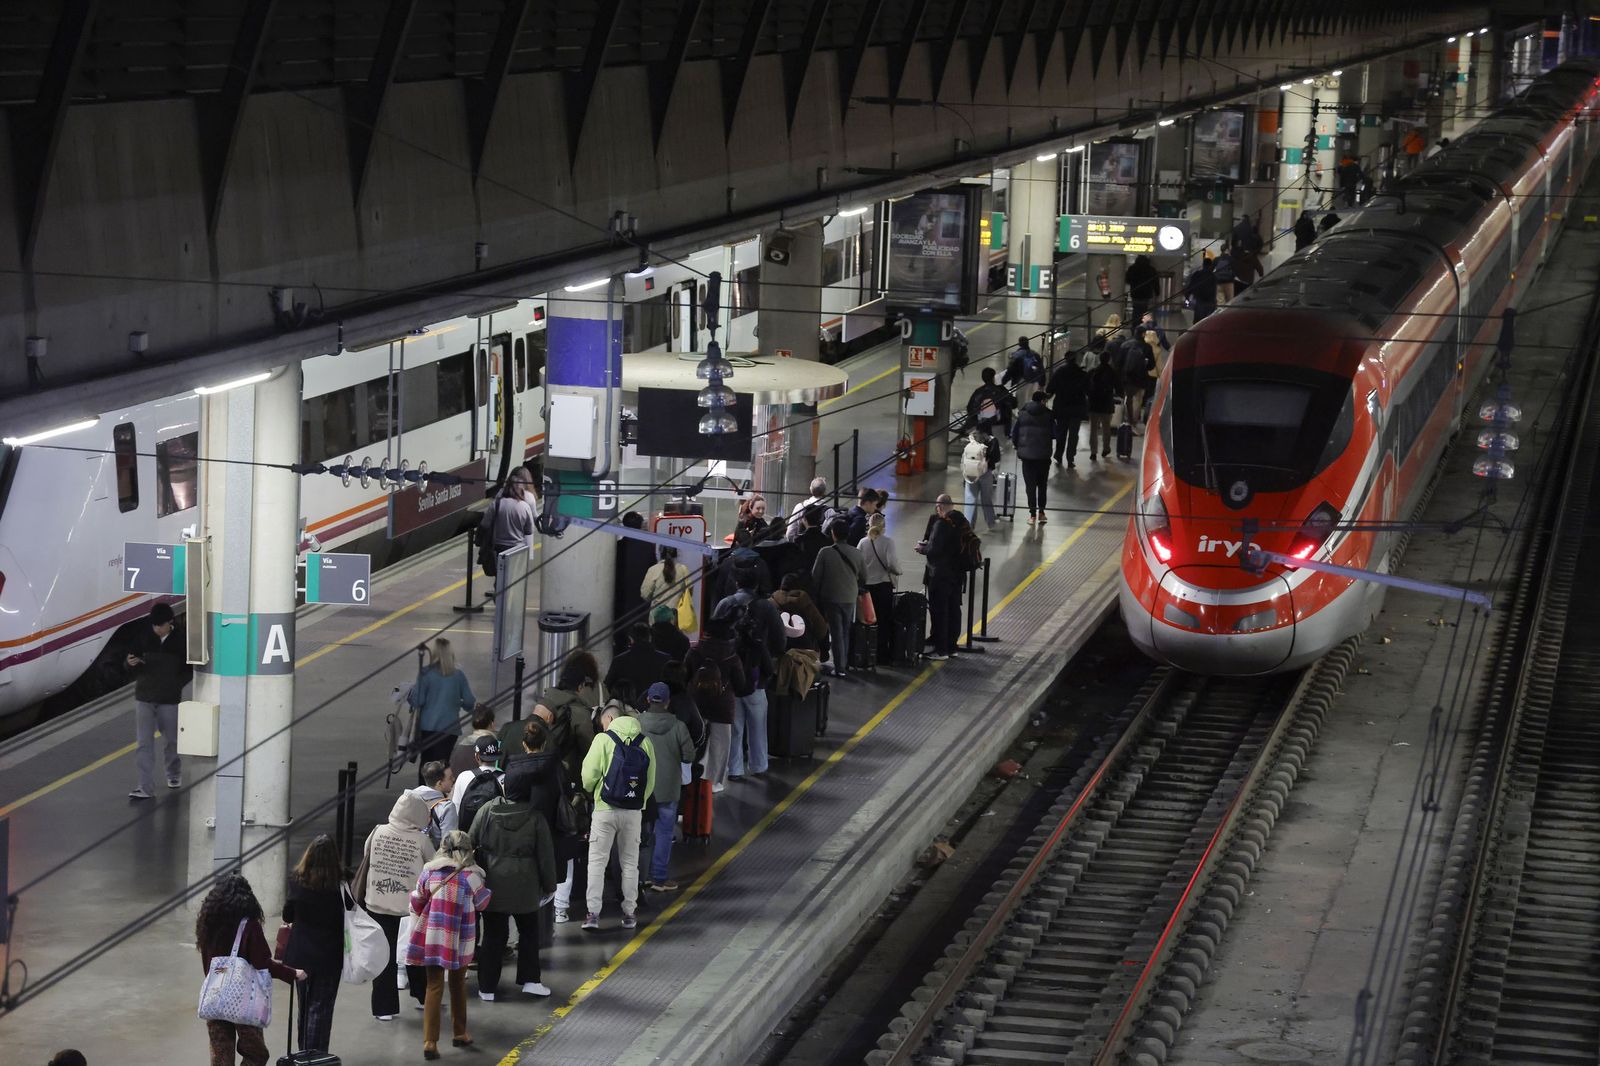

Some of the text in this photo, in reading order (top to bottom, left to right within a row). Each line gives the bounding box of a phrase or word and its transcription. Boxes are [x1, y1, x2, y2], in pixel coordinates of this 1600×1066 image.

[1069, 234, 1080, 249] 6
[1007, 267, 1016, 287] E
[1039, 269, 1051, 289] E
[901, 318, 913, 339] D
[435, 487, 449, 506] Santa
[598, 479, 617, 510] B
[668, 522, 693, 538] iryo
[127, 567, 141, 589] 7
[352, 579, 367, 602] 6
[261, 624, 290, 665] A
